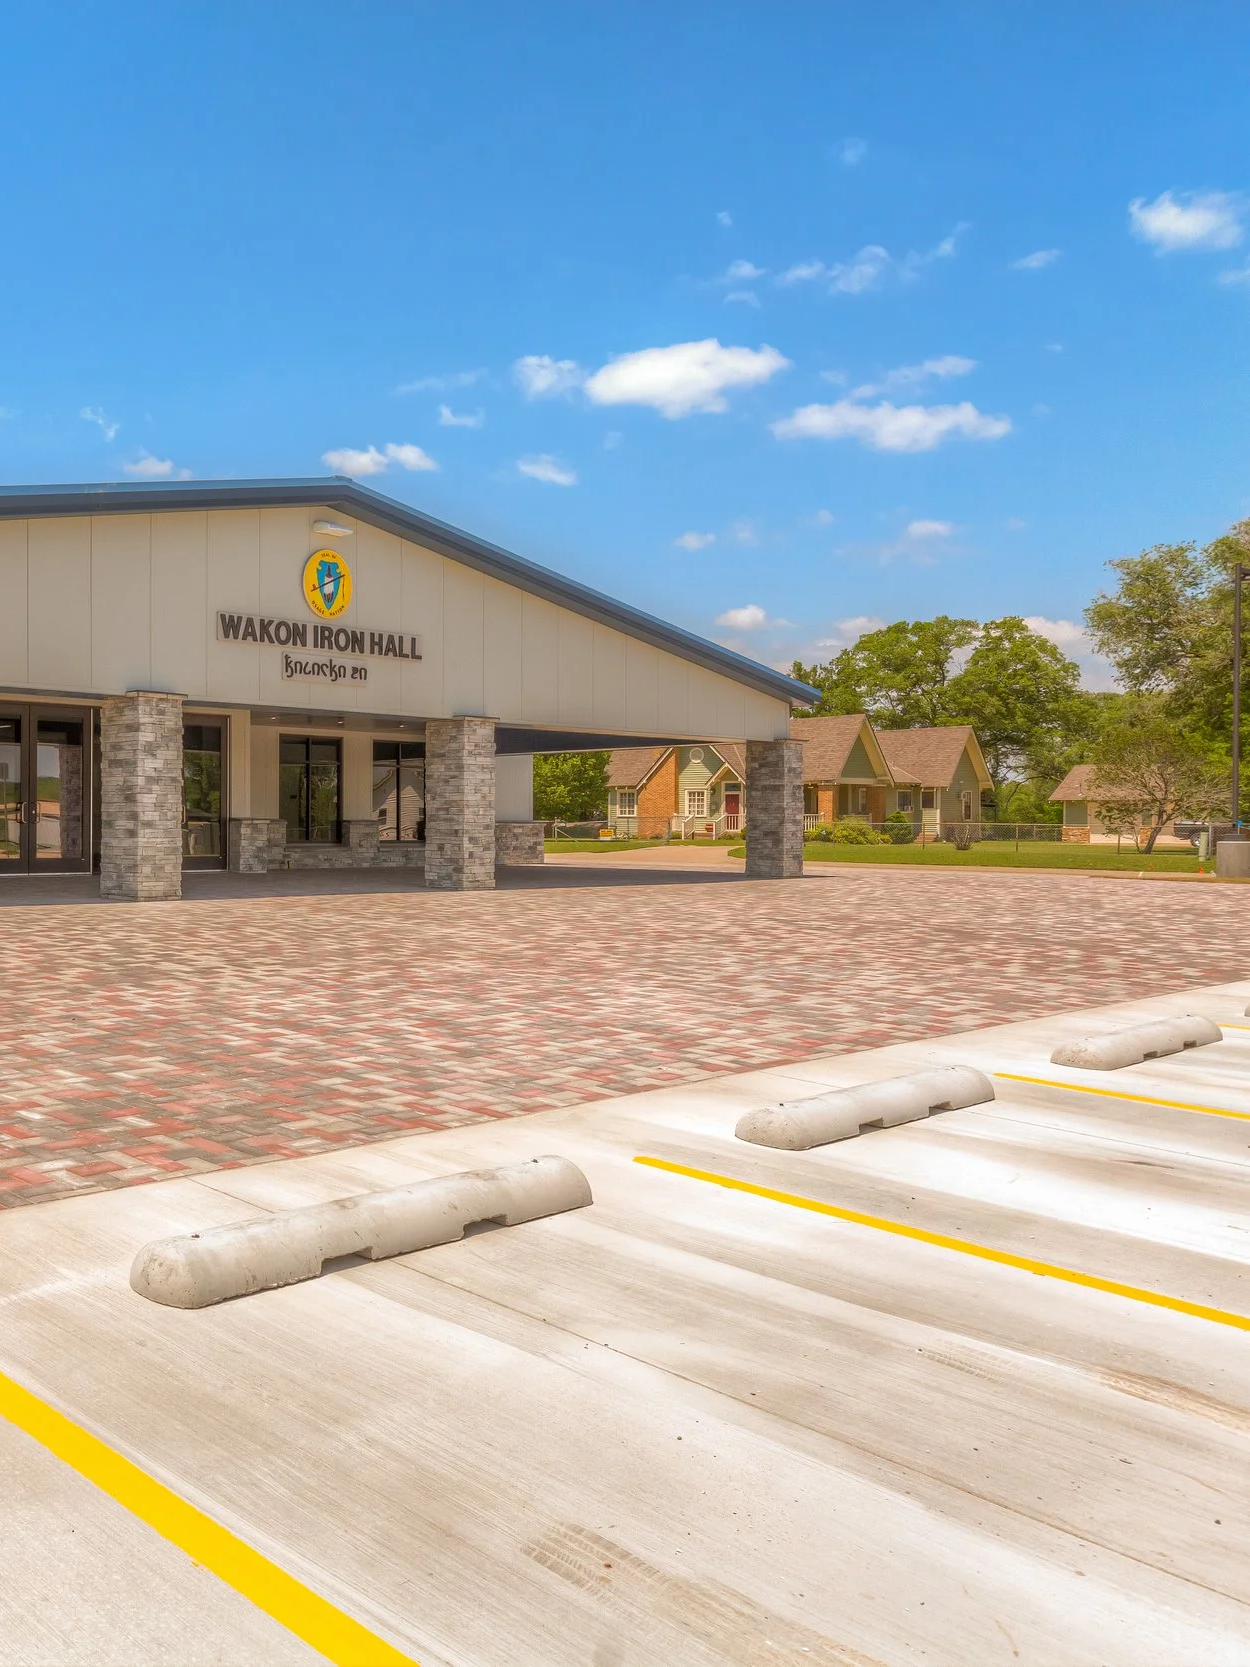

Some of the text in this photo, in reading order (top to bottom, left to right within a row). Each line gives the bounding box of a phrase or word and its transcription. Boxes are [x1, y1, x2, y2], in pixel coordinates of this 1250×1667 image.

[219, 613, 423, 660] WAKON IRON HALL
